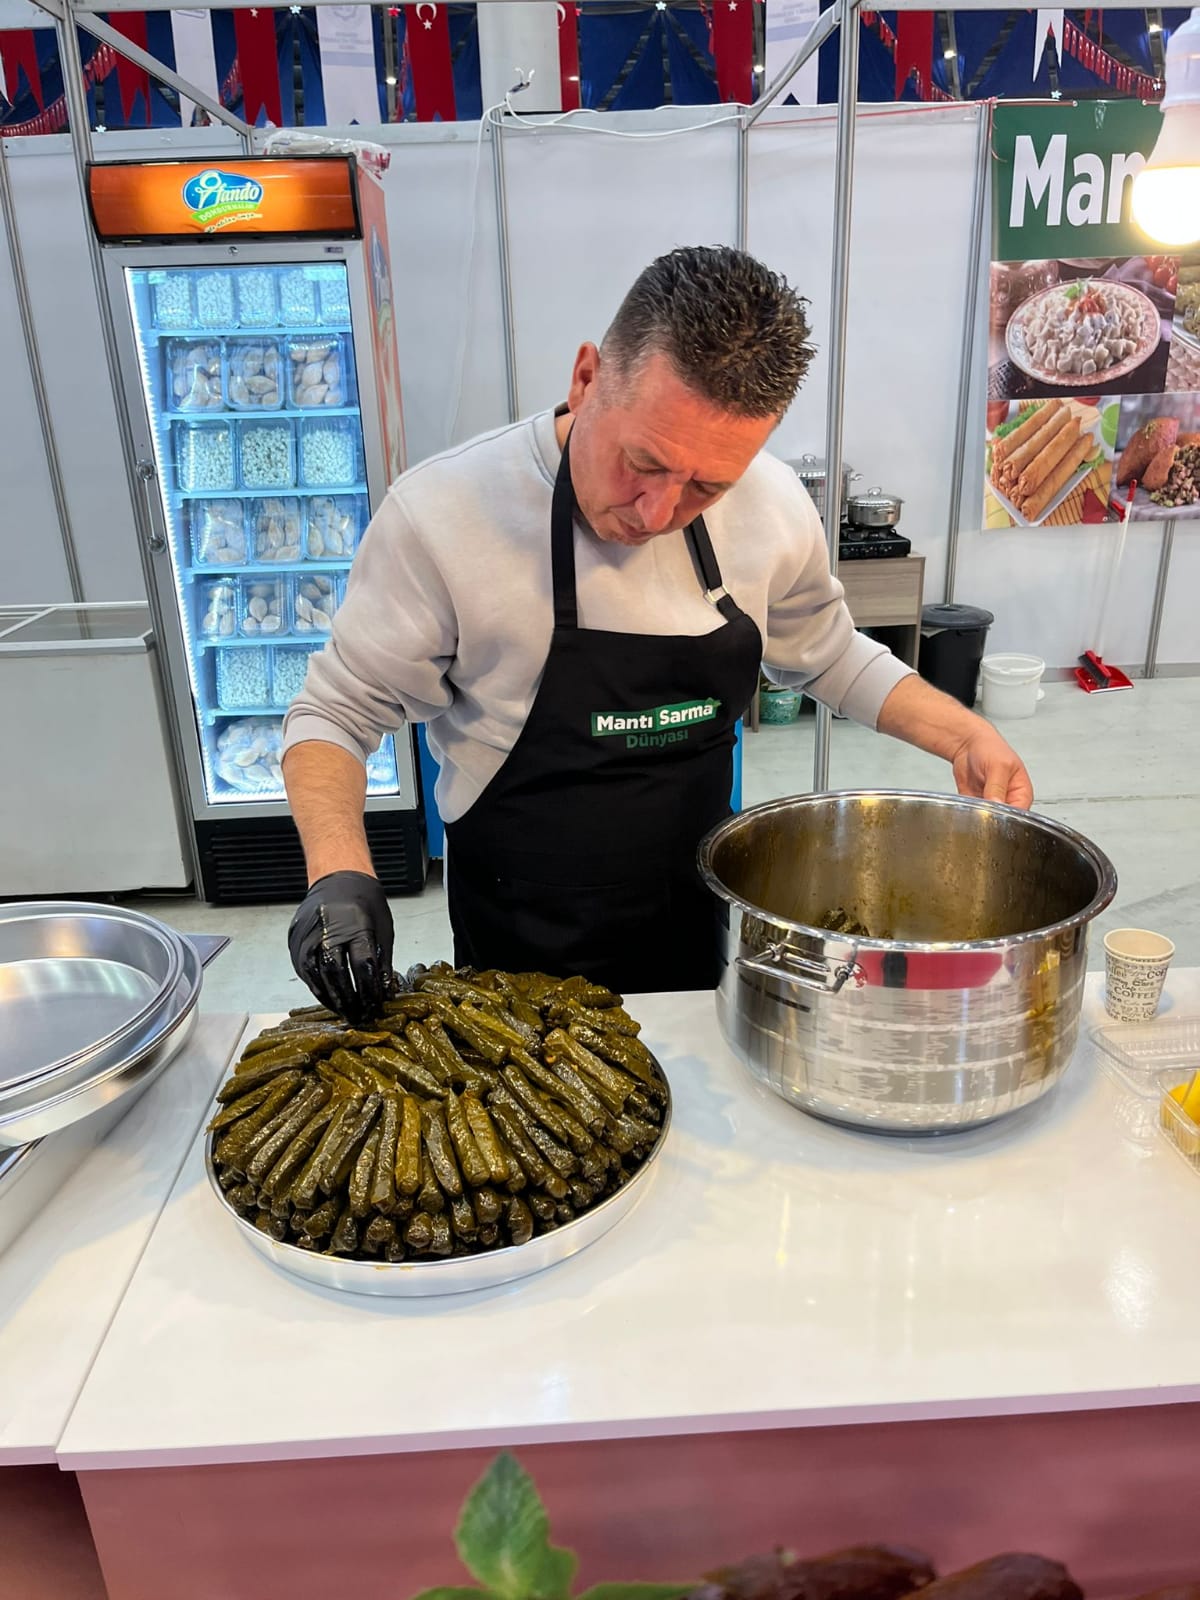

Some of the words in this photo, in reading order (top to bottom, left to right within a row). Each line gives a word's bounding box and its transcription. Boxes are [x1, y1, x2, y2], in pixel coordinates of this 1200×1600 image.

[597, 715, 653, 732] Mantı
[659, 704, 713, 726] Sarma
[626, 729, 689, 749] Dünyası
